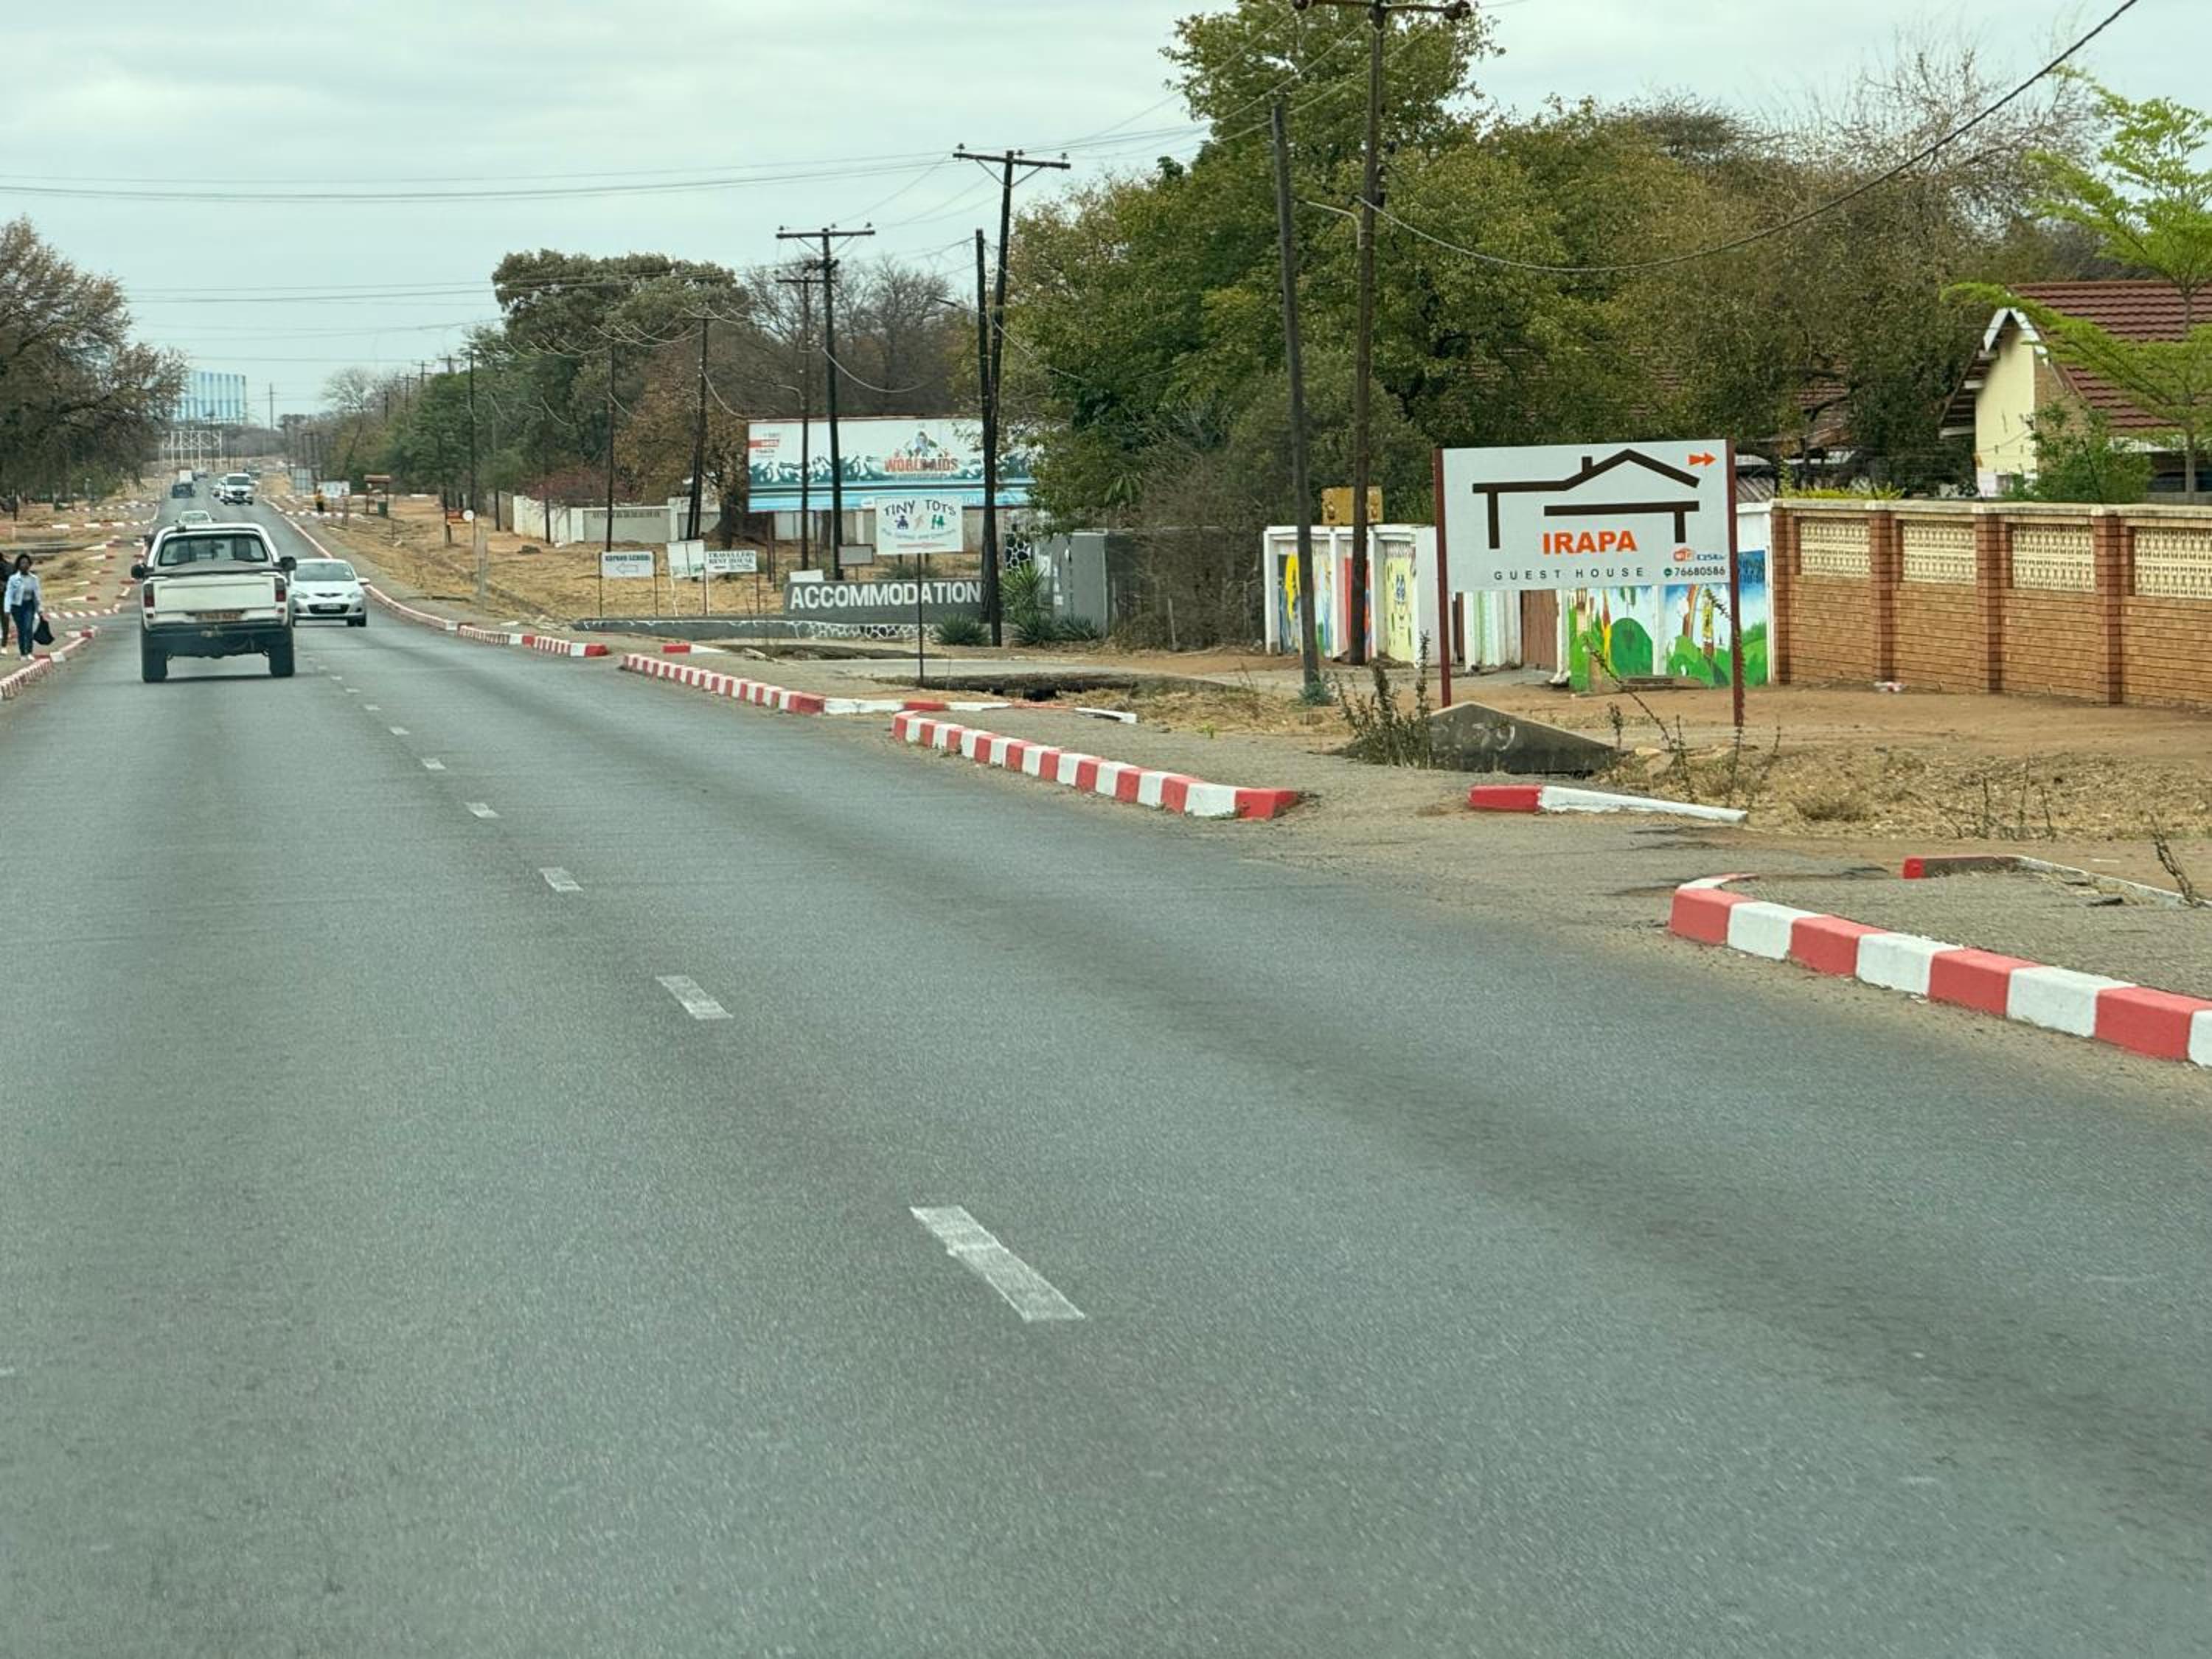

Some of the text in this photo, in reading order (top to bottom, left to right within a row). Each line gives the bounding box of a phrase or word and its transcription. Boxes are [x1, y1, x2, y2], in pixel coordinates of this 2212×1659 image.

[884, 499, 956, 516] TINY TOTS
[1543, 530, 1638, 554] IRAPA
[1494, 567, 1644, 580] GUEST HOUSE
[1674, 566, 1726, 576] 76680586
[790, 581, 982, 610] ACCOMMODATION
